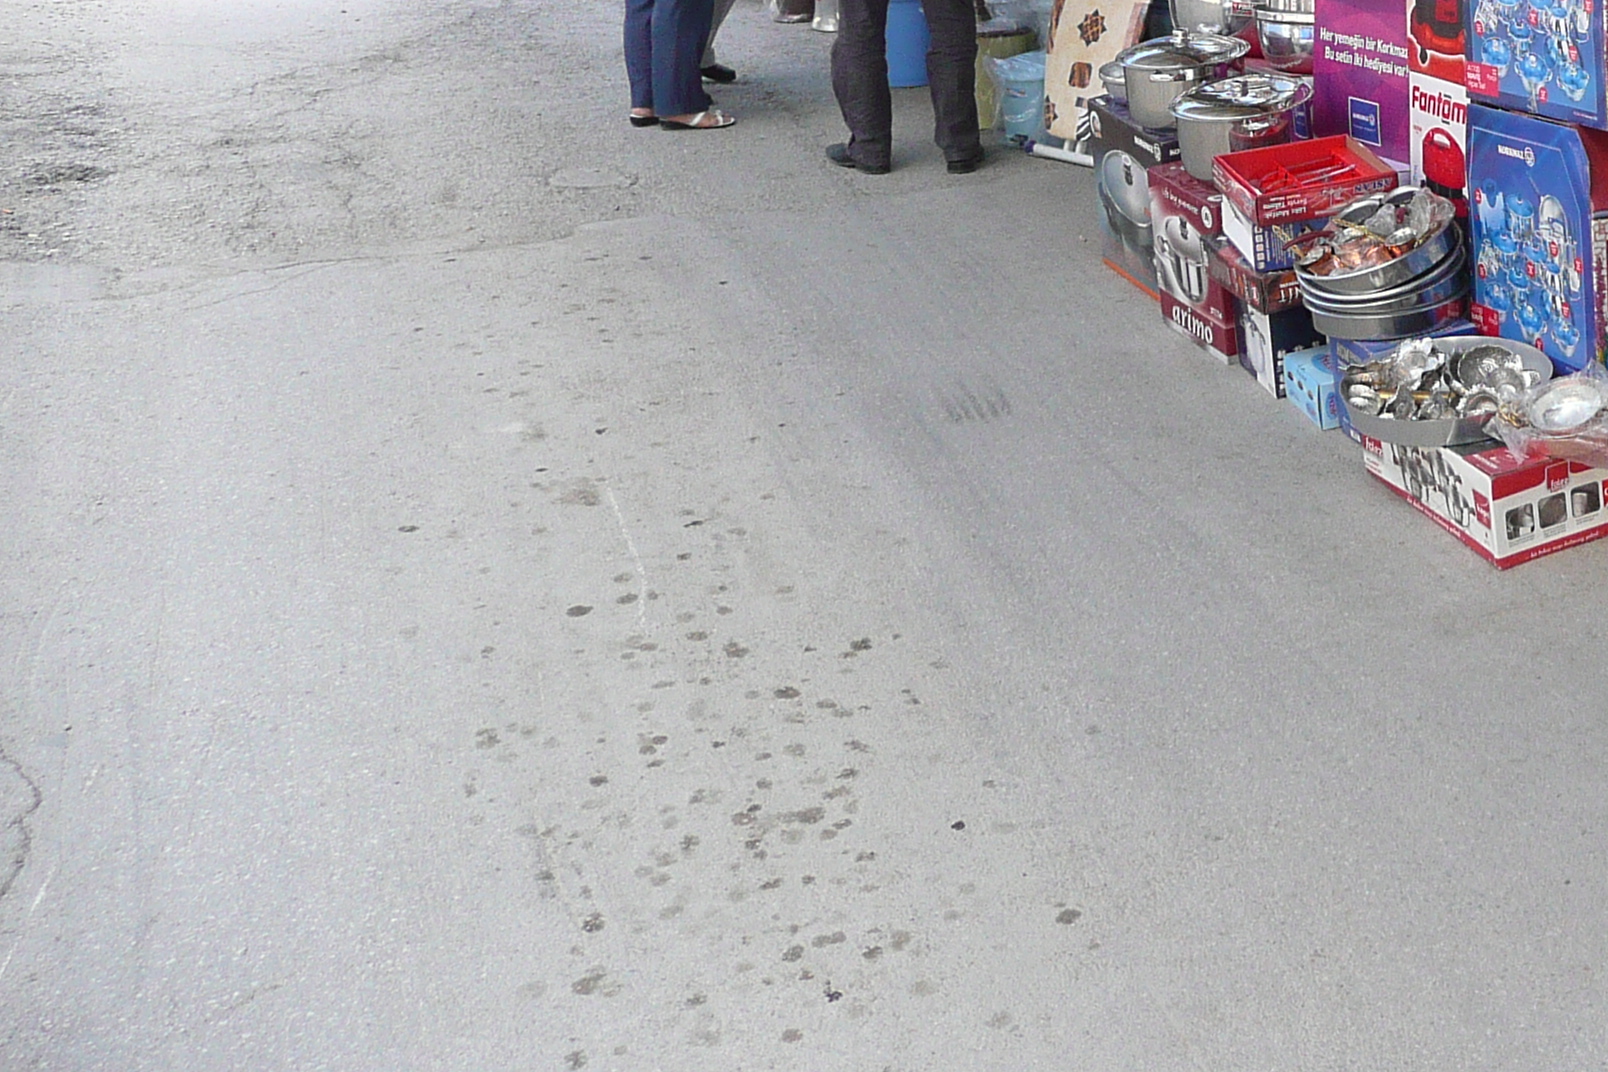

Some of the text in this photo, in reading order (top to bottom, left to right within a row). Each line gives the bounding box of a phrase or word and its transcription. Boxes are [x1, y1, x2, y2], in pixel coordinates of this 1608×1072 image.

[1320, 26, 1333, 42] Her
[1333, 31, 1364, 50] yemeğin
[1366, 37, 1376, 49] bir
[1324, 46, 1334, 59] Bu
[1335, 50, 1352, 64] setin
[1364, 55, 1393, 74] hediyesi
[1172, 304, 1213, 344] arimo
